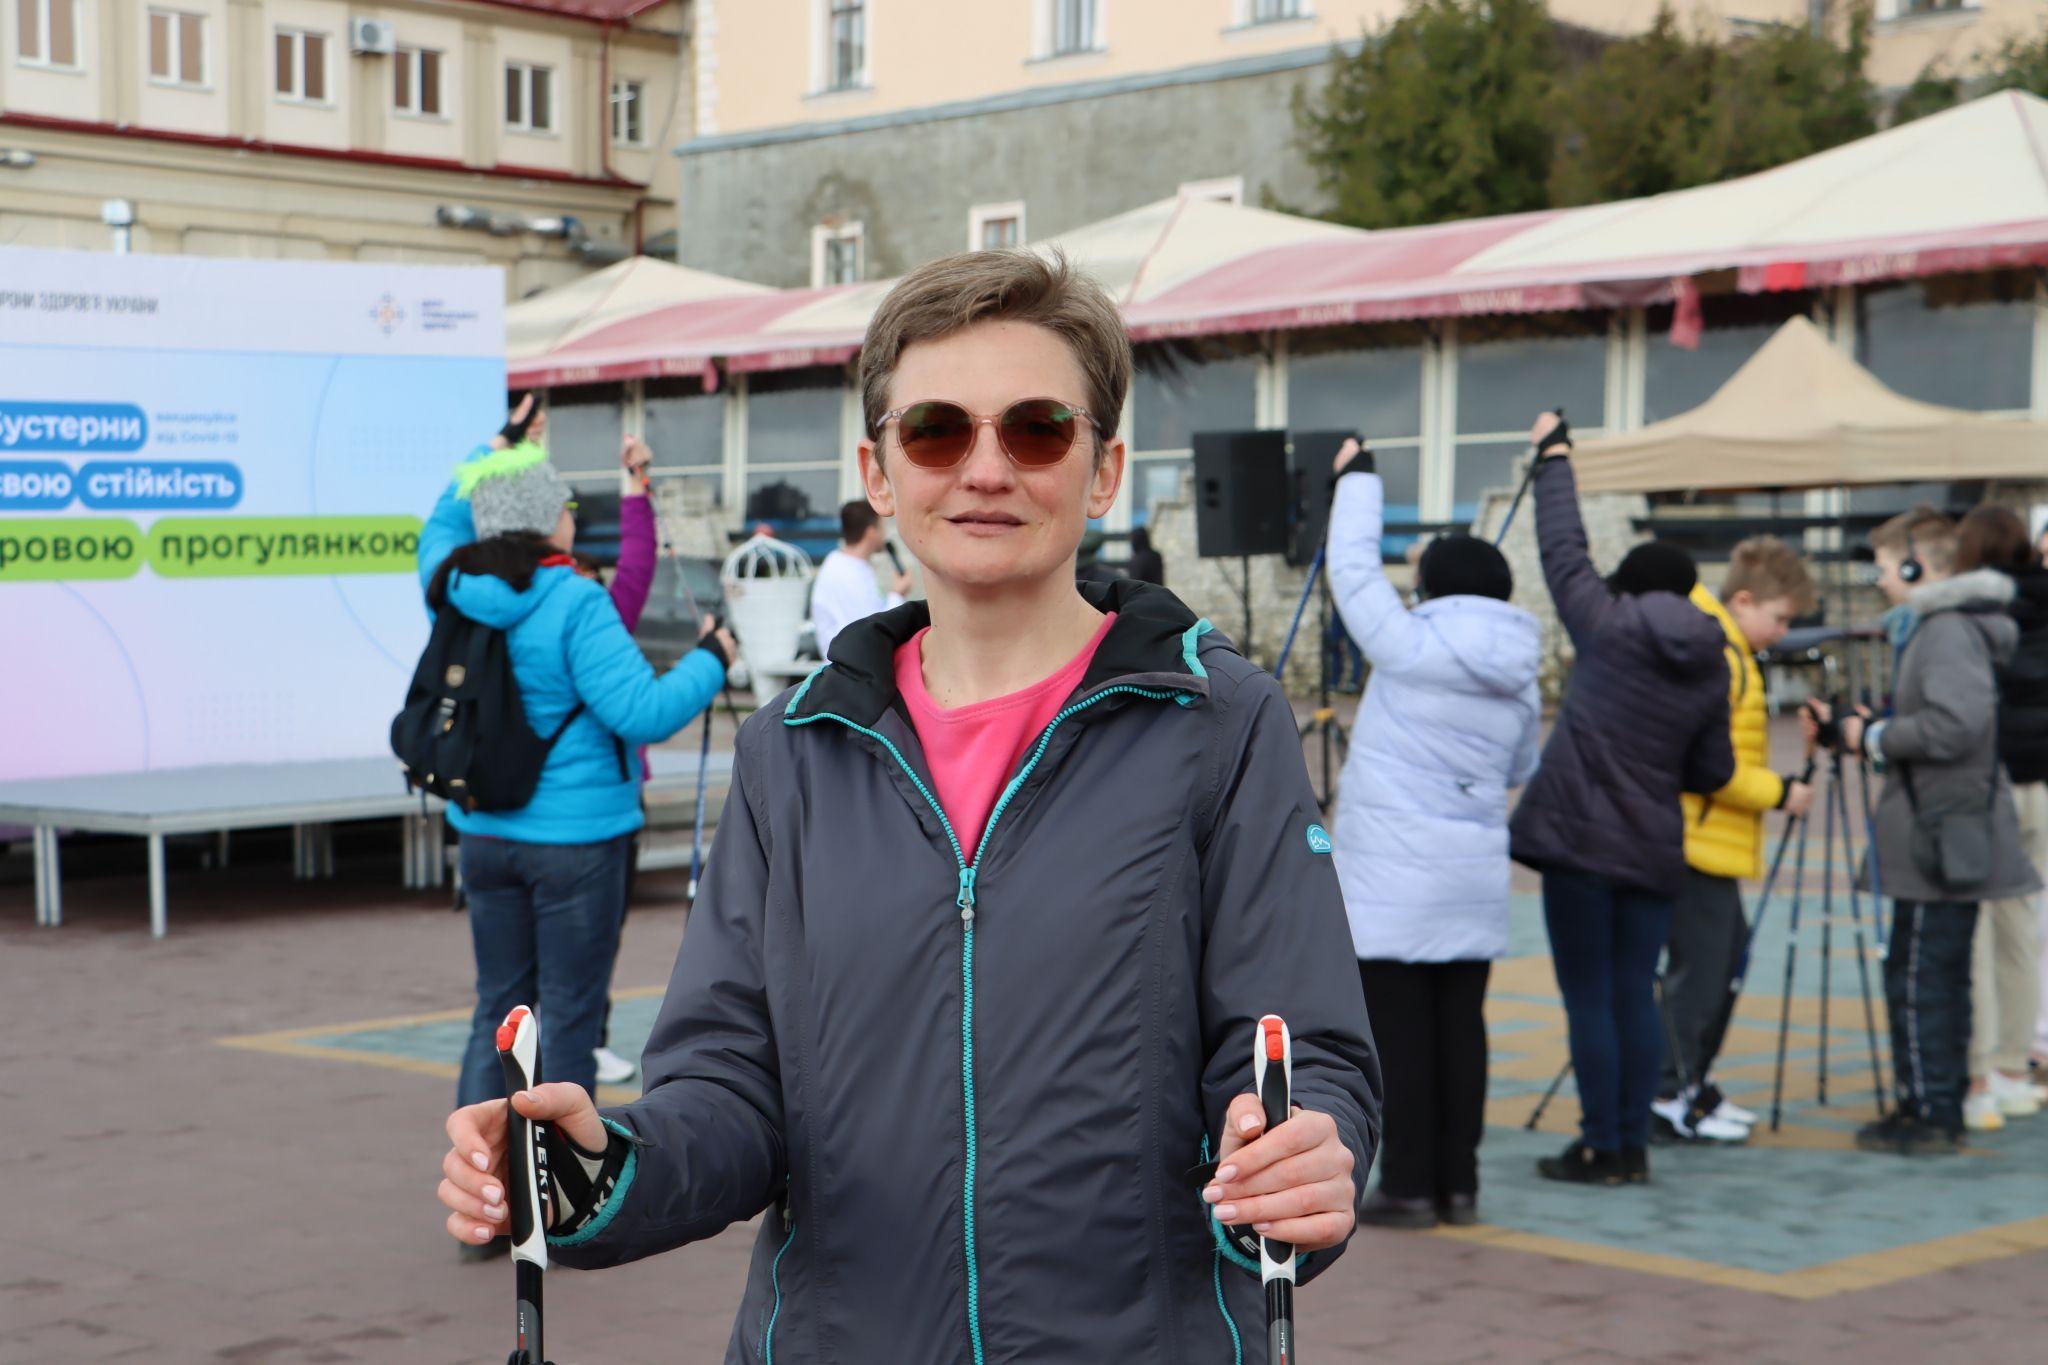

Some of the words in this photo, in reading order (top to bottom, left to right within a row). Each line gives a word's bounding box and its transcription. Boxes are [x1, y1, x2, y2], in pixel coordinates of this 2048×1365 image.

[0, 411, 141, 446] устерни
[0, 472, 72, 497] вою
[88, 467, 236, 498] стійкість
[162, 532, 419, 564] прогулянкою
[535, 1125, 549, 1200] LEKI
